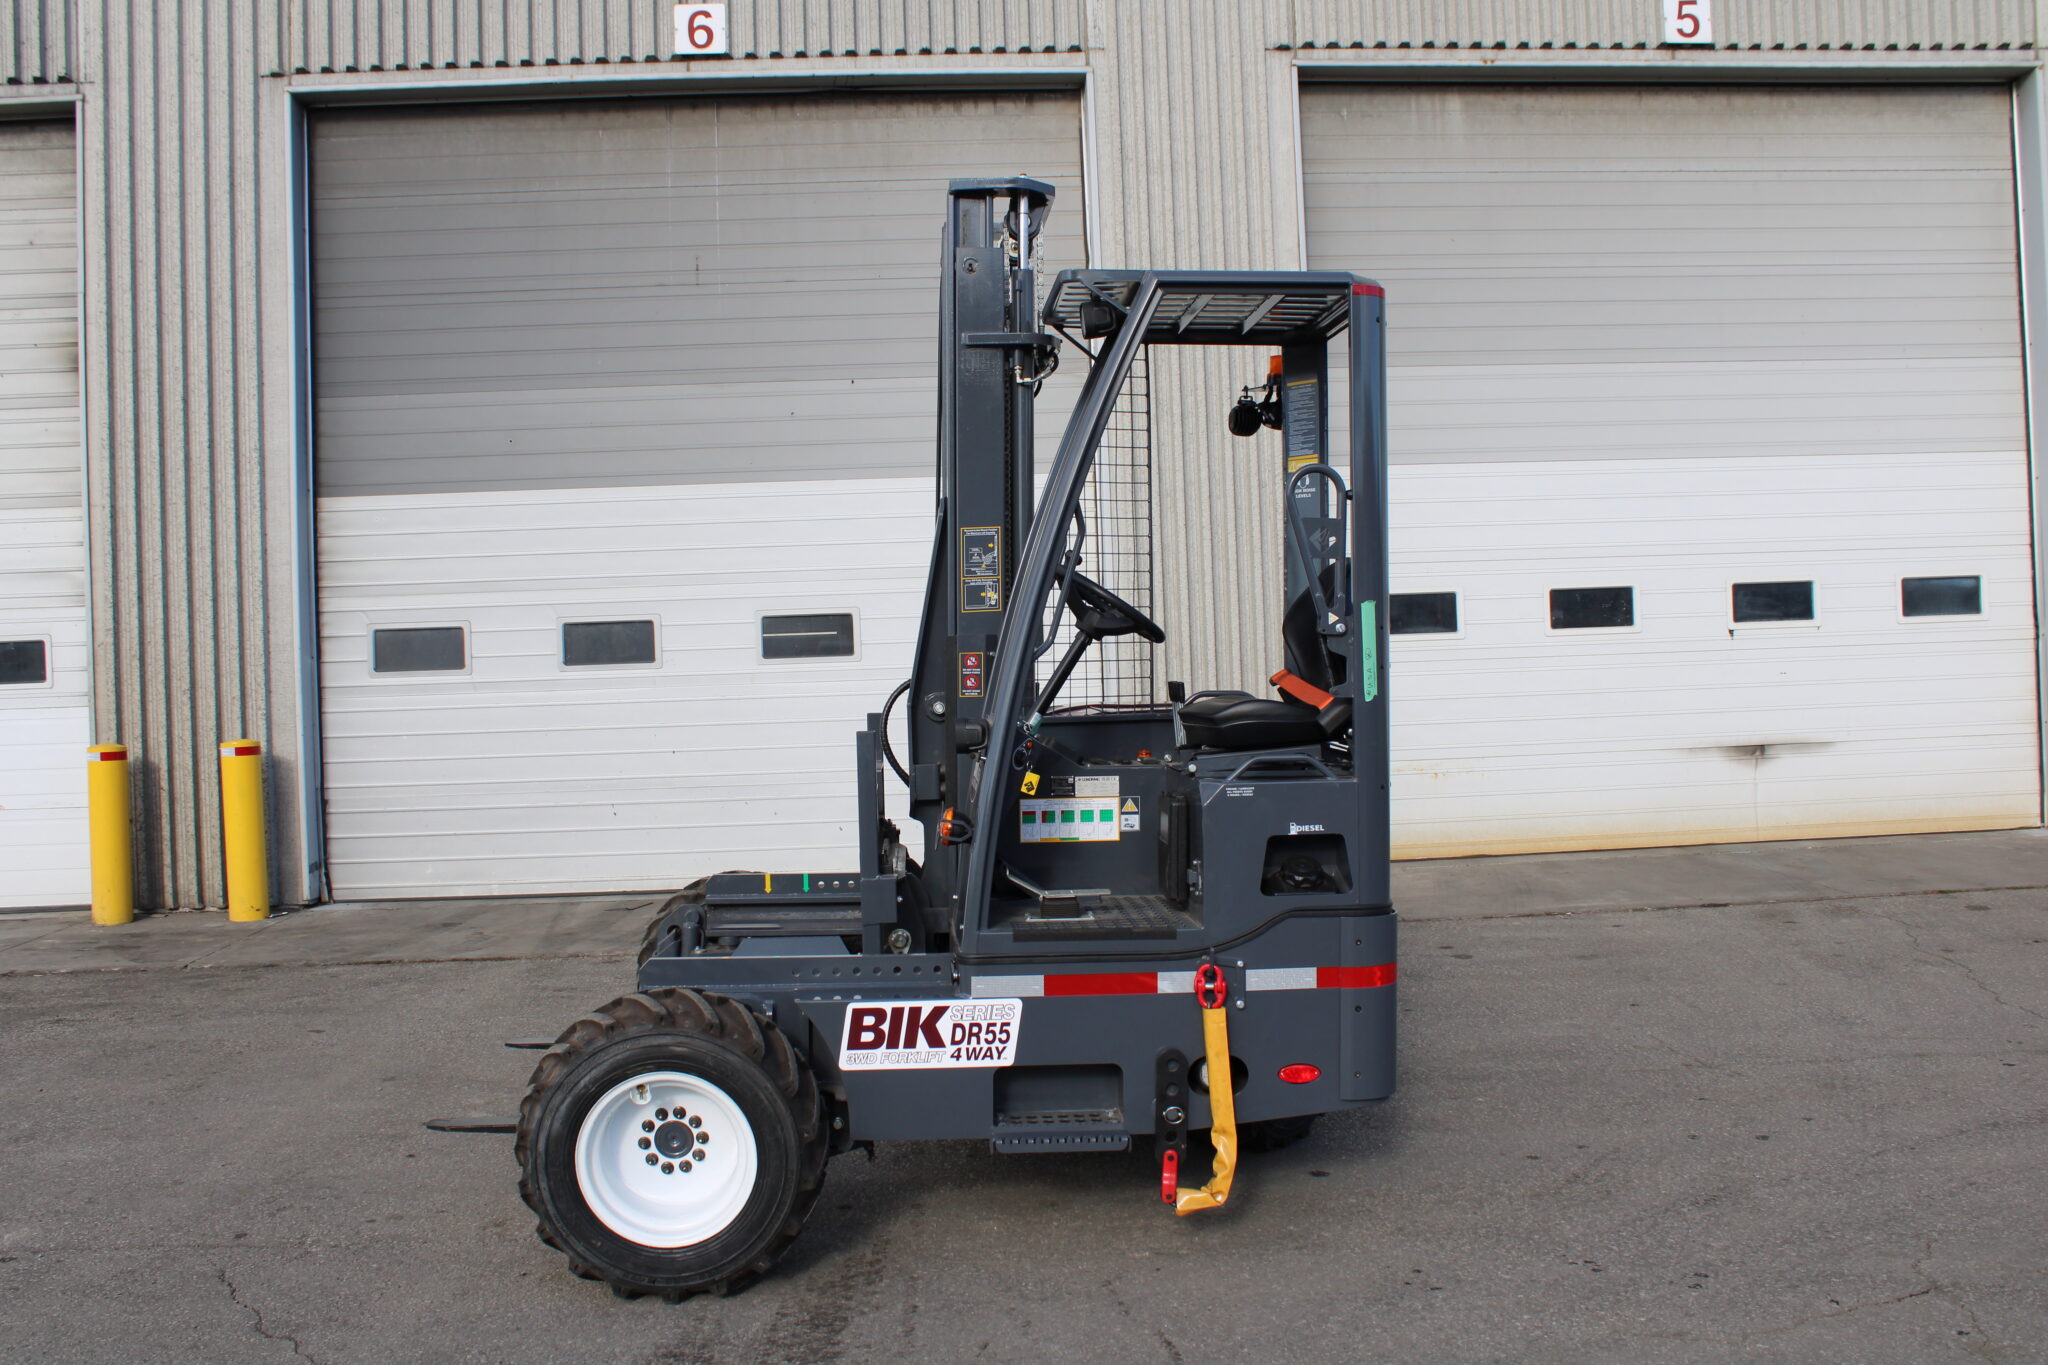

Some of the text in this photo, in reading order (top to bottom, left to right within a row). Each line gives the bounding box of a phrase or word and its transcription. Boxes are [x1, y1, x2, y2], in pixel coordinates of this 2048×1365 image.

[687, 10, 714, 49] 6
[1676, 0, 1700, 38] 5
[1296, 824, 1325, 832] DIESEL
[950, 1003, 1015, 1021] SERIES
[847, 1005, 950, 1051] BIK
[951, 1022, 1011, 1046] DR55
[846, 1051, 946, 1065] 3WD FORKLIFT
[950, 1046, 1007, 1061] 4 WAY
